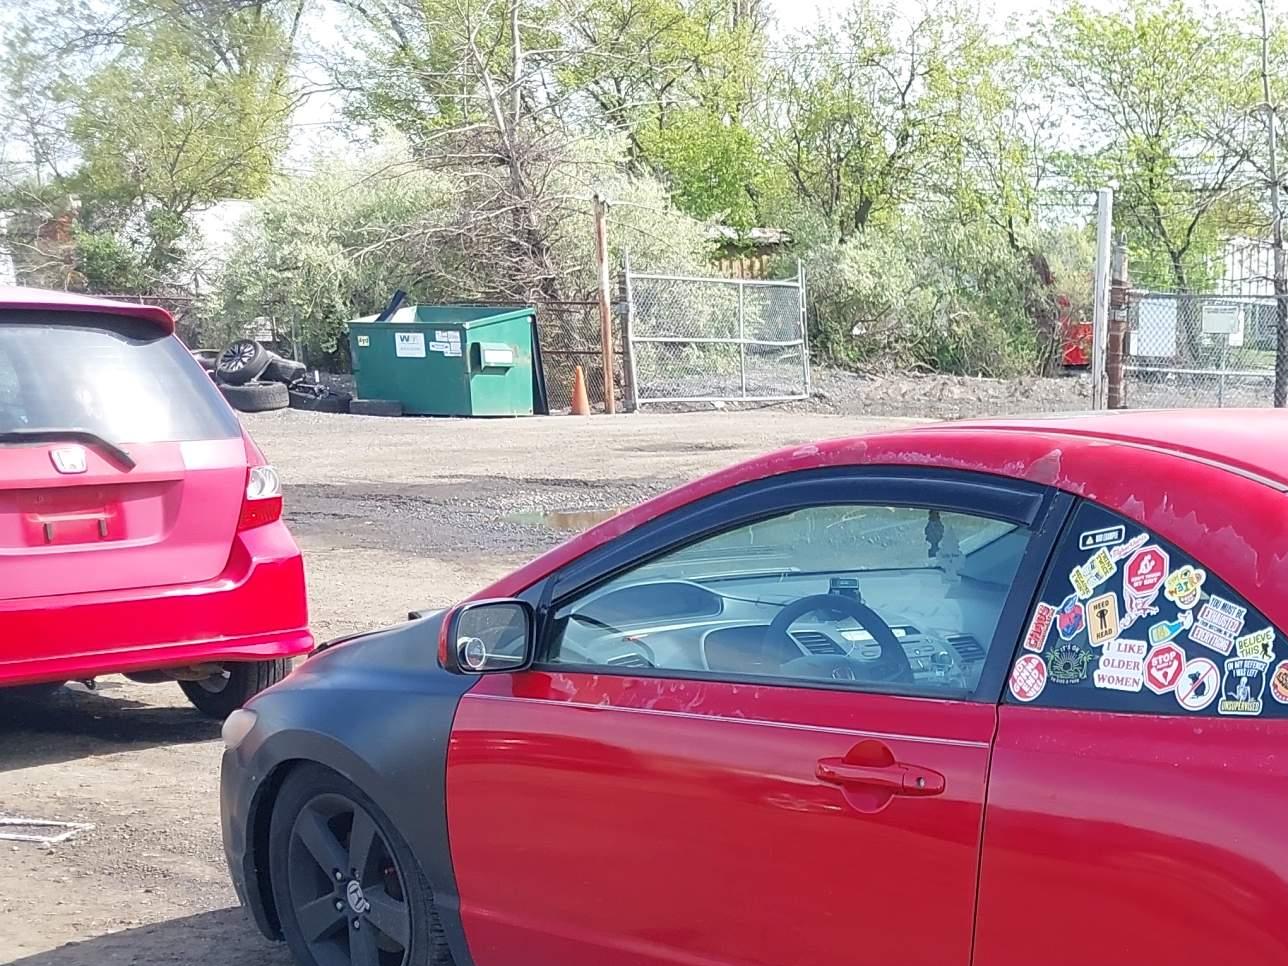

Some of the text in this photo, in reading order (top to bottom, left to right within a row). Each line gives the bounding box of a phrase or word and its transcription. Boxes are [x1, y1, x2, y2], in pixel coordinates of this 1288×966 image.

[1093, 600, 1109, 611] NEED
[1210, 598, 1245, 619] YOU MUST BE
[1096, 628, 1113, 640] HEAD
[1239, 630, 1272, 649] BELIEVE
[1106, 642, 1145, 655] I LIKE
[1240, 645, 1259, 658] THIS
[1103, 658, 1140, 671] OLDER
[1151, 651, 1177, 667] STOP
[1097, 673, 1141, 687] WOMEN
